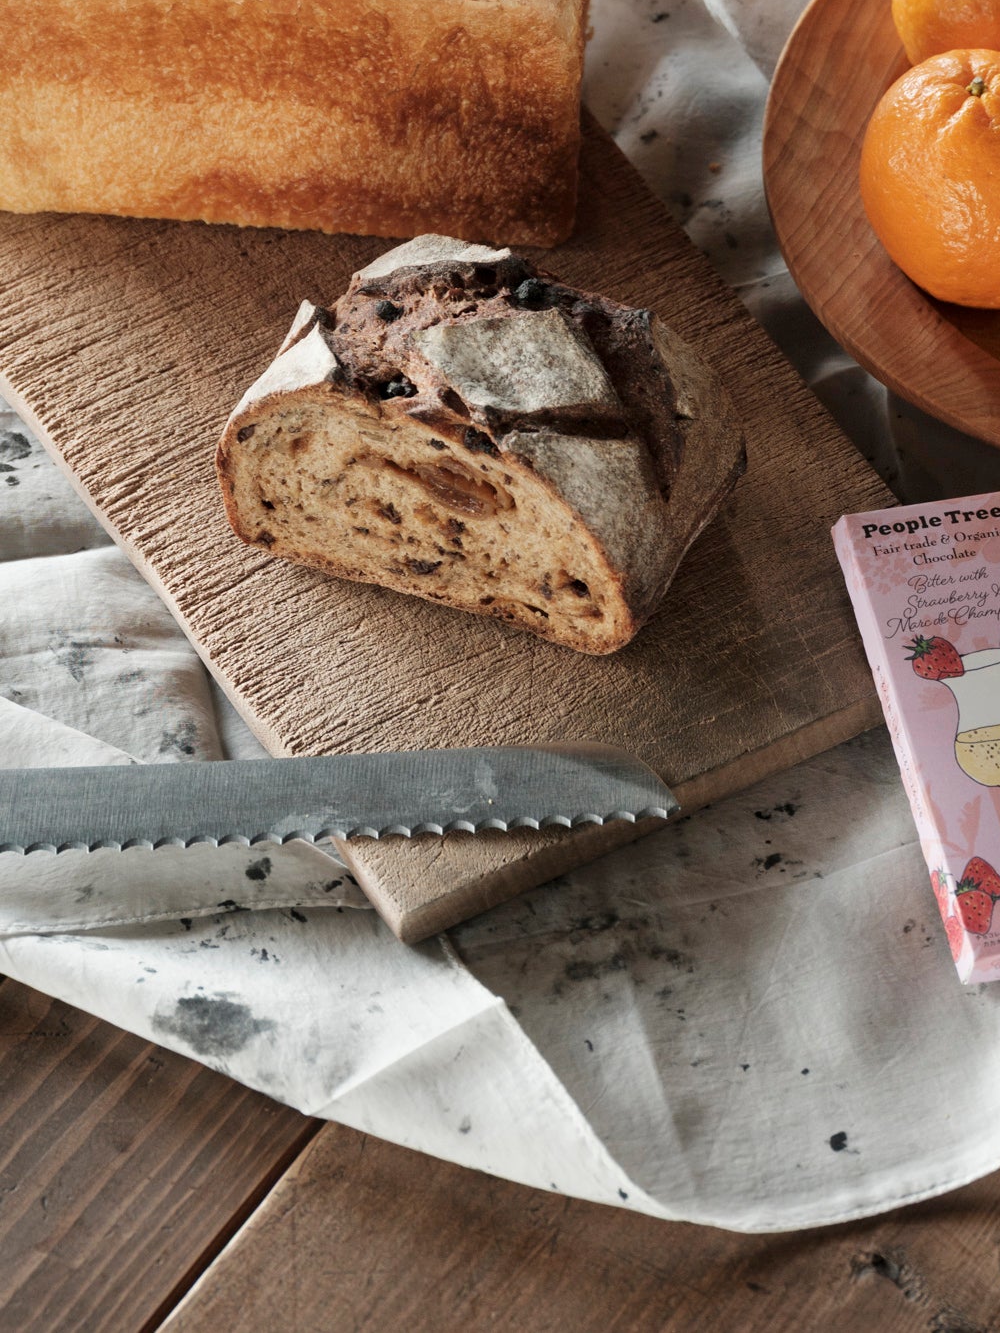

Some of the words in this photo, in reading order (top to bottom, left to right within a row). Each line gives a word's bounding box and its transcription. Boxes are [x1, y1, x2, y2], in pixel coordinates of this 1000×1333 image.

[862, 516, 942, 539] People
[873, 545, 901, 557] Fair
[904, 536, 937, 551] trade
[940, 534, 950, 545] &
[913, 548, 977, 566] Chocolate
[907, 571, 956, 594] Bitter
[959, 567, 989, 584] with
[903, 589, 989, 619] Strawberry
[885, 616, 934, 639] Marc
[933, 611, 949, 626] de
